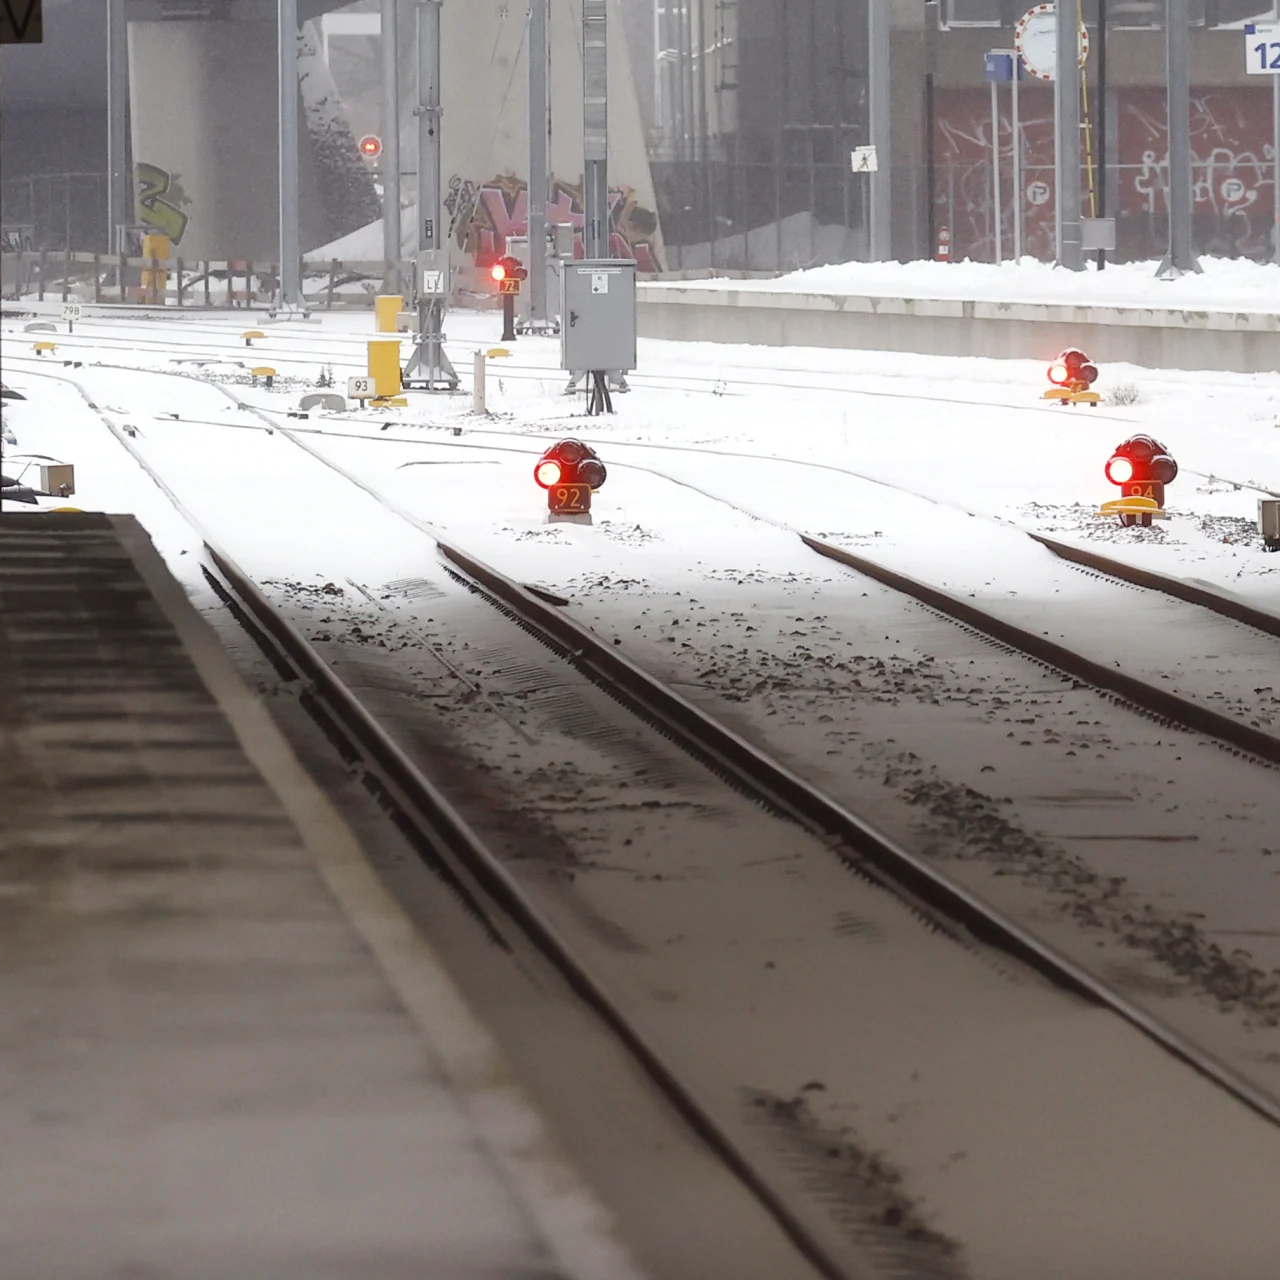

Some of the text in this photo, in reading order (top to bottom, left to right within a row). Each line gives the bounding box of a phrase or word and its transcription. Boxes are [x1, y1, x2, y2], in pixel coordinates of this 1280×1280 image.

[503, 280, 515, 291] 72
[63, 306, 80, 315] 79B
[355, 380, 368, 392] 93
[556, 488, 581, 507] 92
